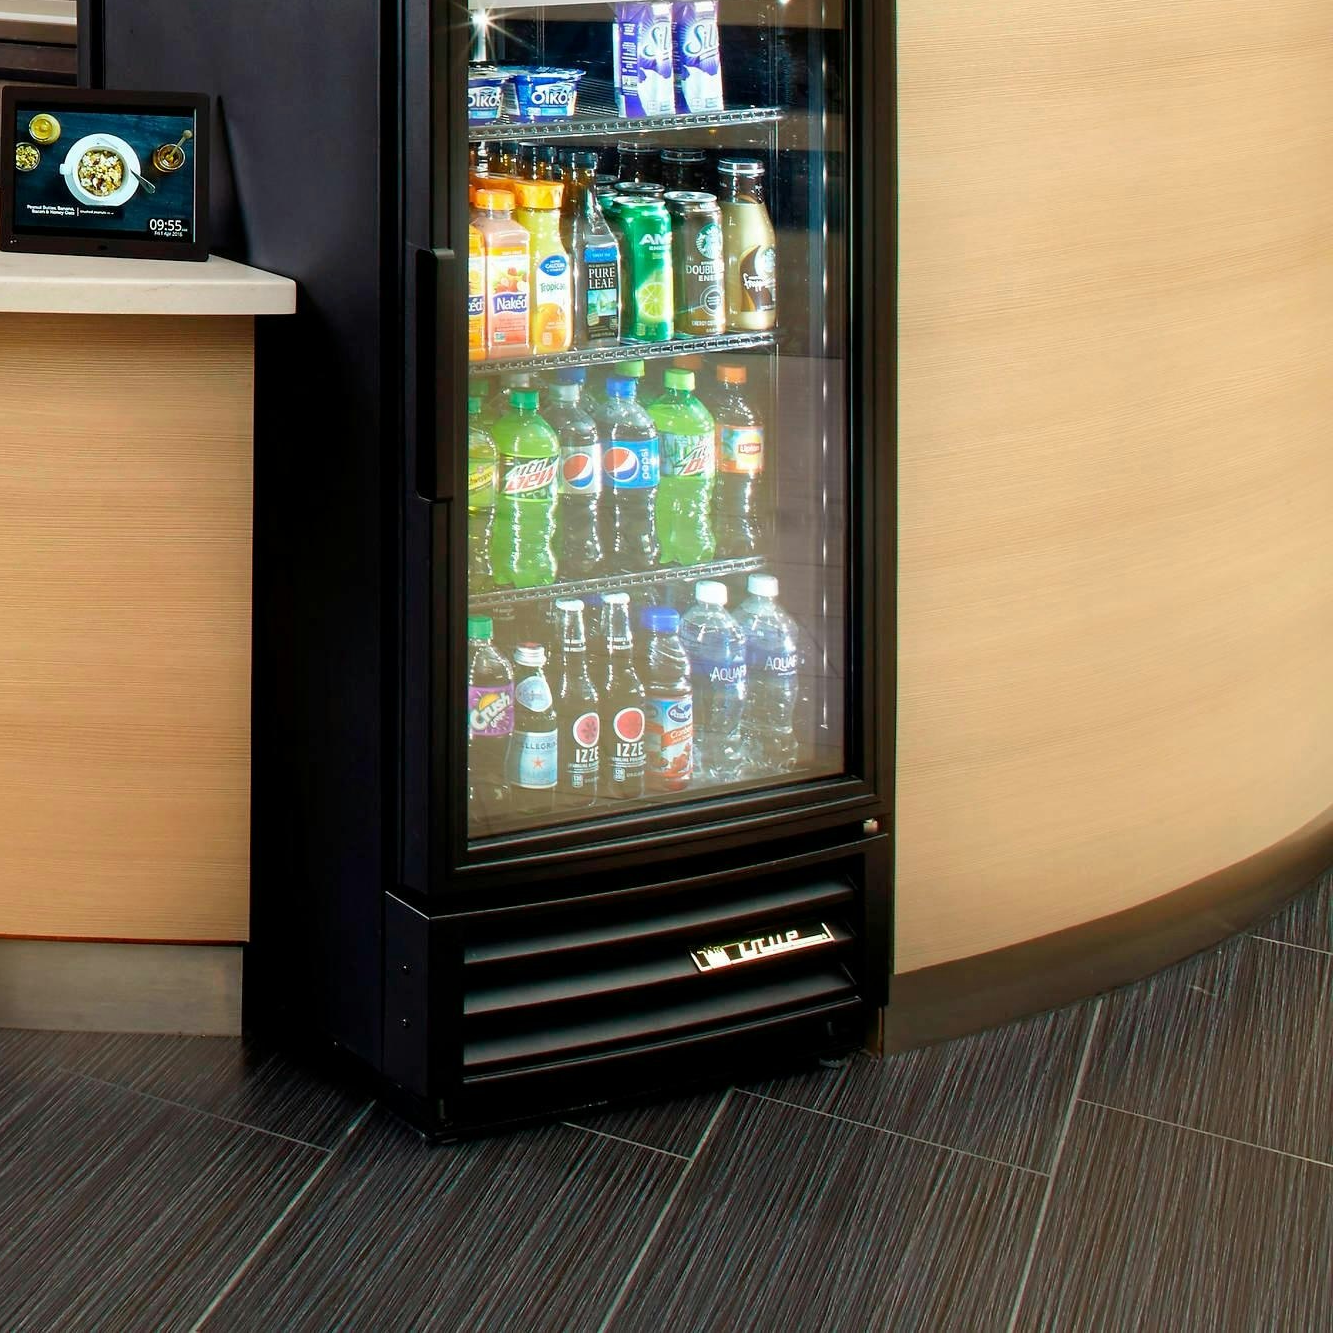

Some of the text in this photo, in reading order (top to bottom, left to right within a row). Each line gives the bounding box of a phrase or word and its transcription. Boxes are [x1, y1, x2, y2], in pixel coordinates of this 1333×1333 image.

[149, 218, 182, 231] 09:55
[588, 267, 615, 279] PURE
[739, 444, 761, 454] Lipton
[641, 449, 652, 479] pepsi
[471, 692, 511, 731] Crush
[576, 746, 600, 763] IZZE
[617, 741, 644, 757] IZZE
